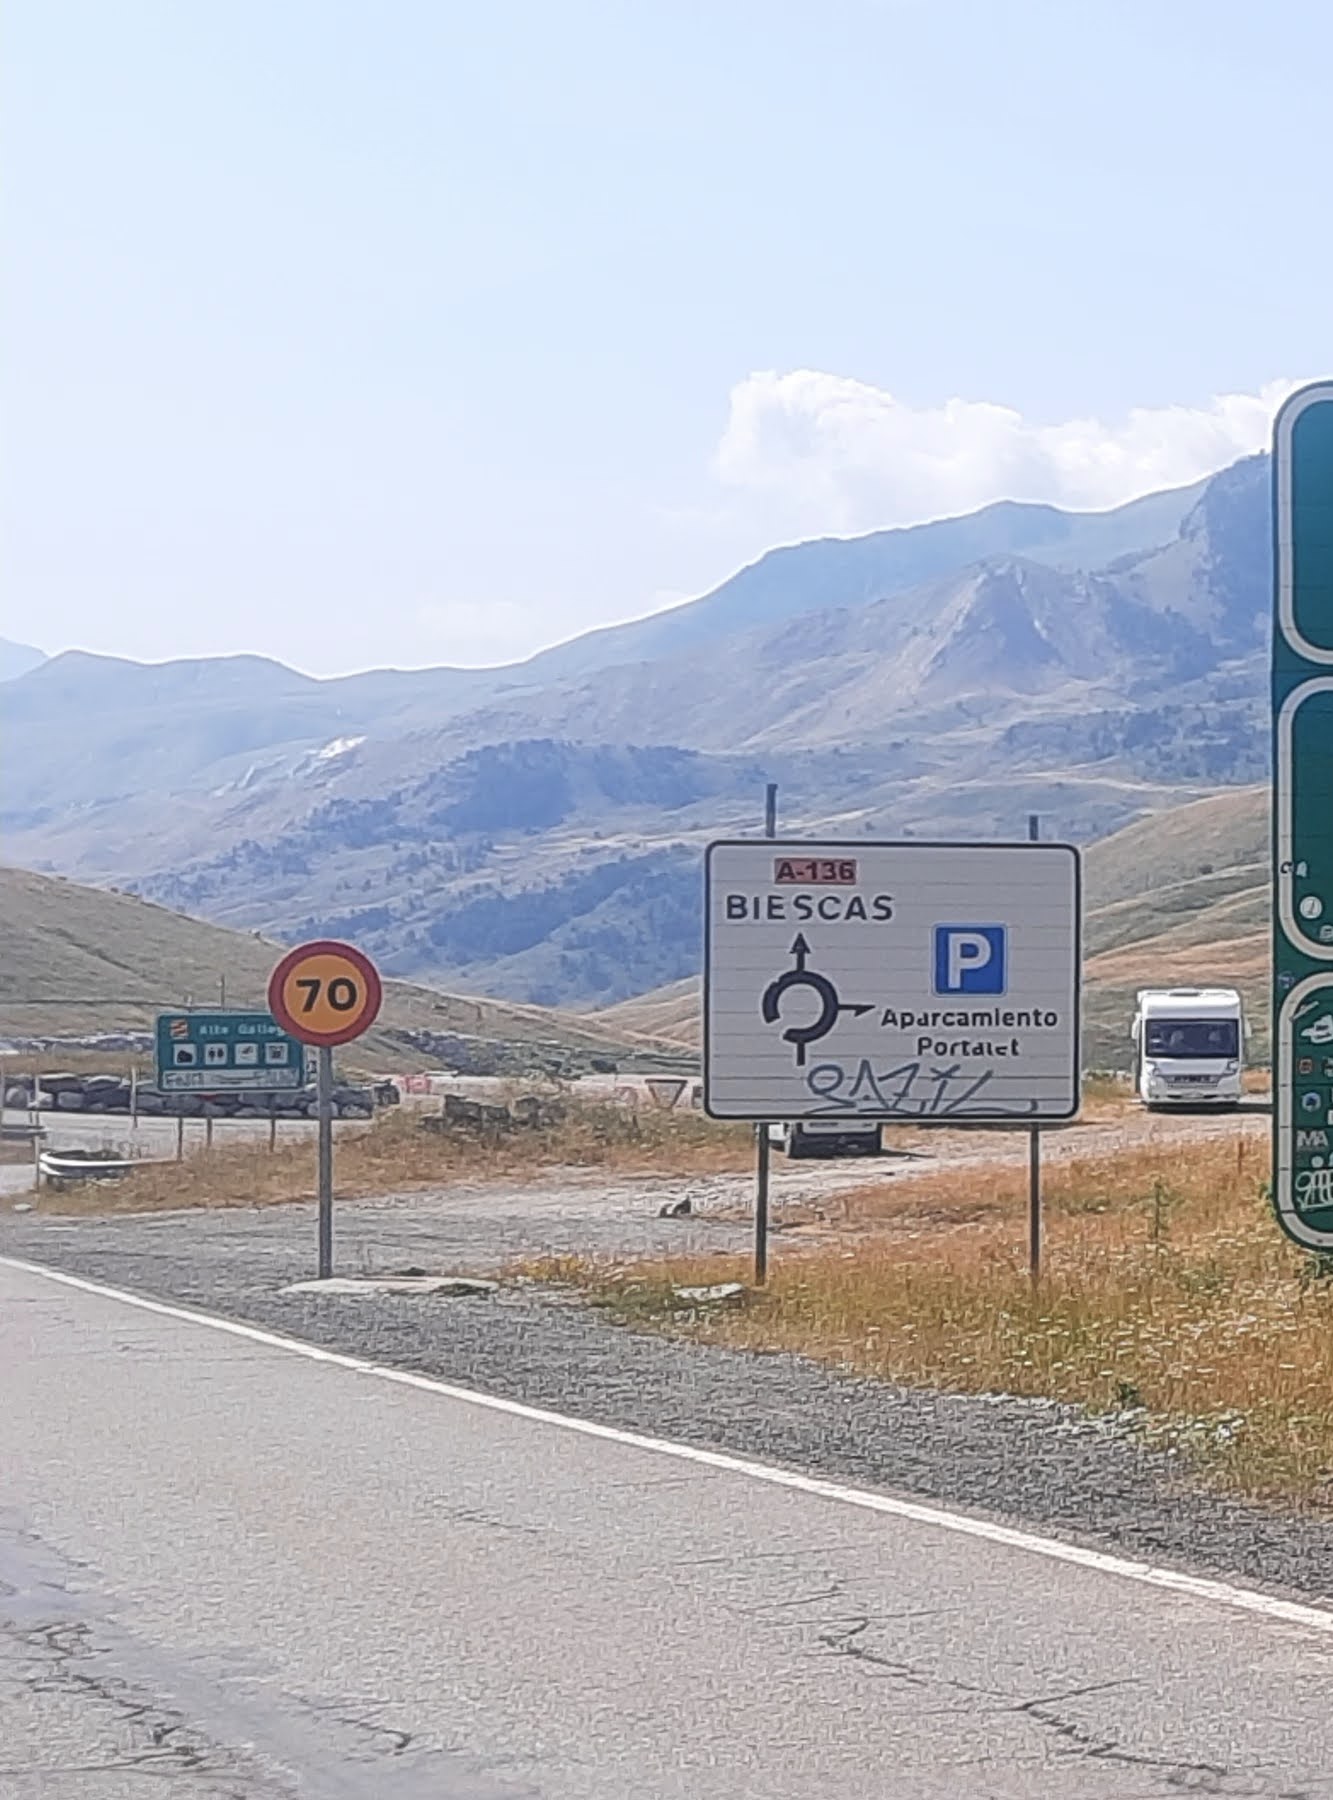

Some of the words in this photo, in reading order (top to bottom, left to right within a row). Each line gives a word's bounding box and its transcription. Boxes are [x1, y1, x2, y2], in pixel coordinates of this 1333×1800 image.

[777, 859, 856, 882] A-136
[726, 895, 894, 921] BIESCAS
[948, 933, 992, 988] P
[296, 977, 358, 1013] 70
[881, 1008, 1058, 1029] Aparcamiento
[917, 1037, 1020, 1057] Portalet
